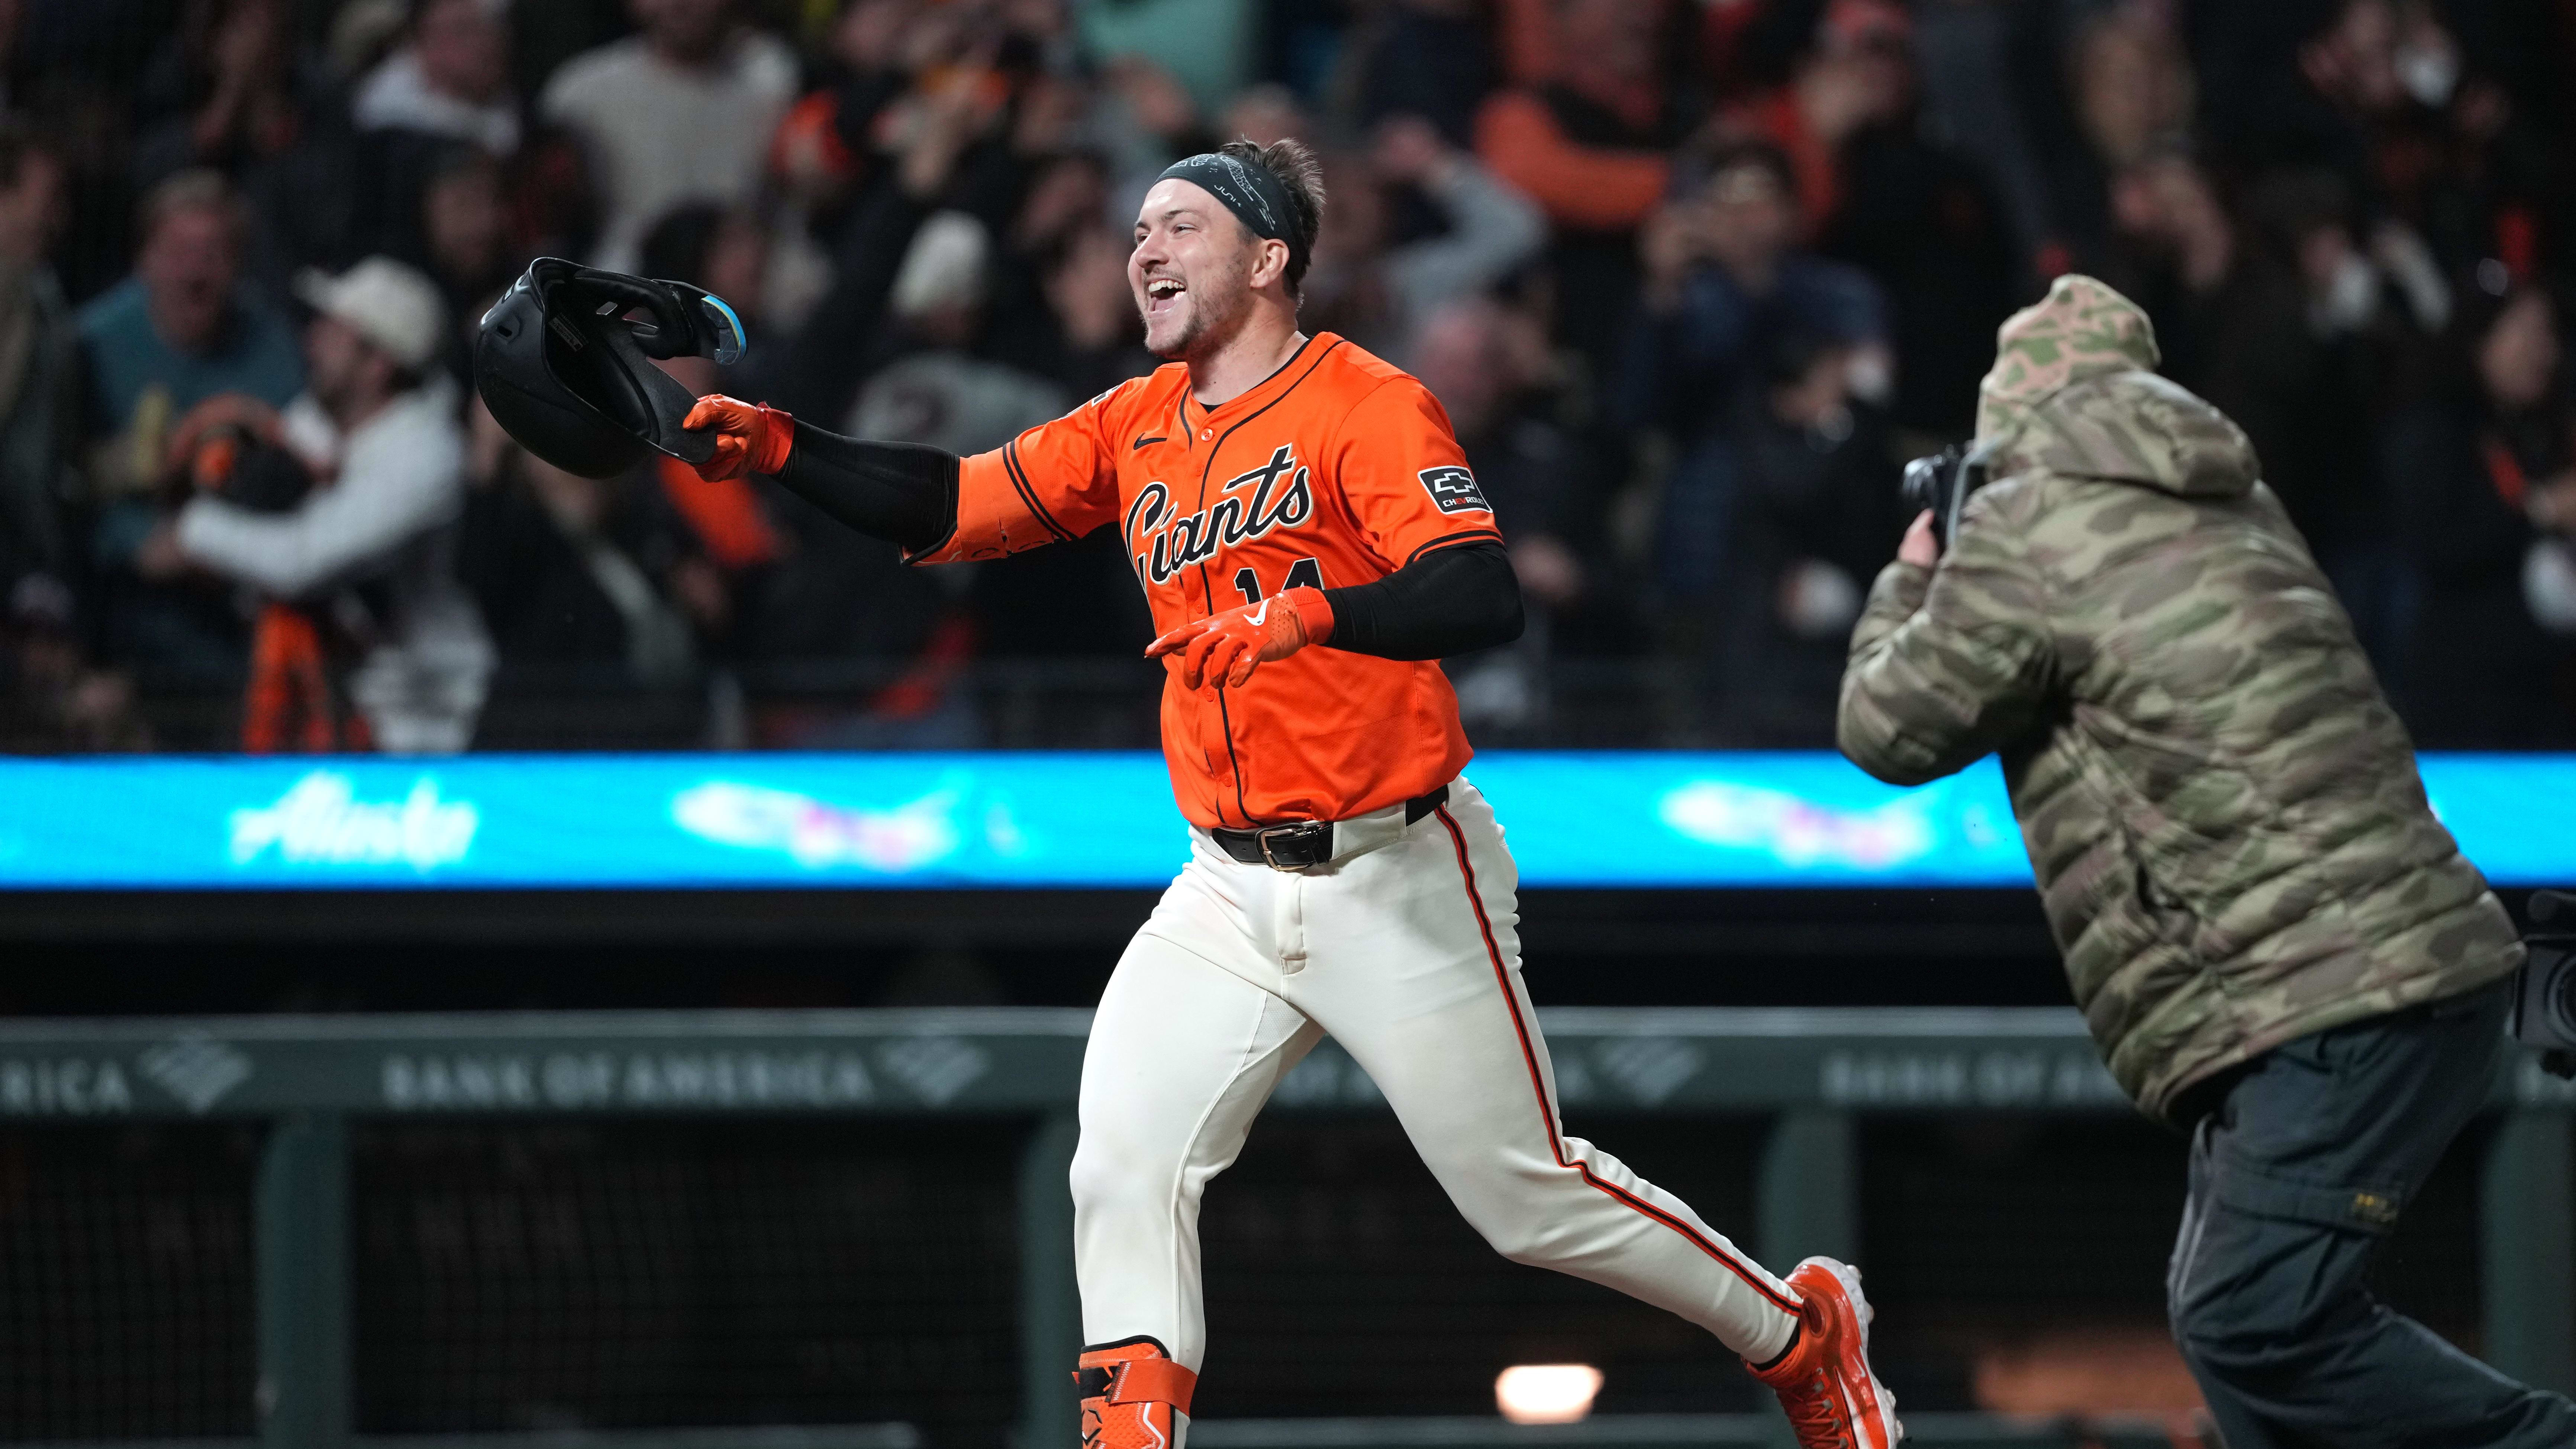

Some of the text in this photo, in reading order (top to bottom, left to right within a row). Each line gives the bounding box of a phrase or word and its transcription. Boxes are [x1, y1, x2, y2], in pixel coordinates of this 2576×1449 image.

[1125, 442, 1313, 594] Giants
[1442, 497, 1485, 507] CHEVROLET
[381, 1052, 876, 1112] BANK OF AMERICA
